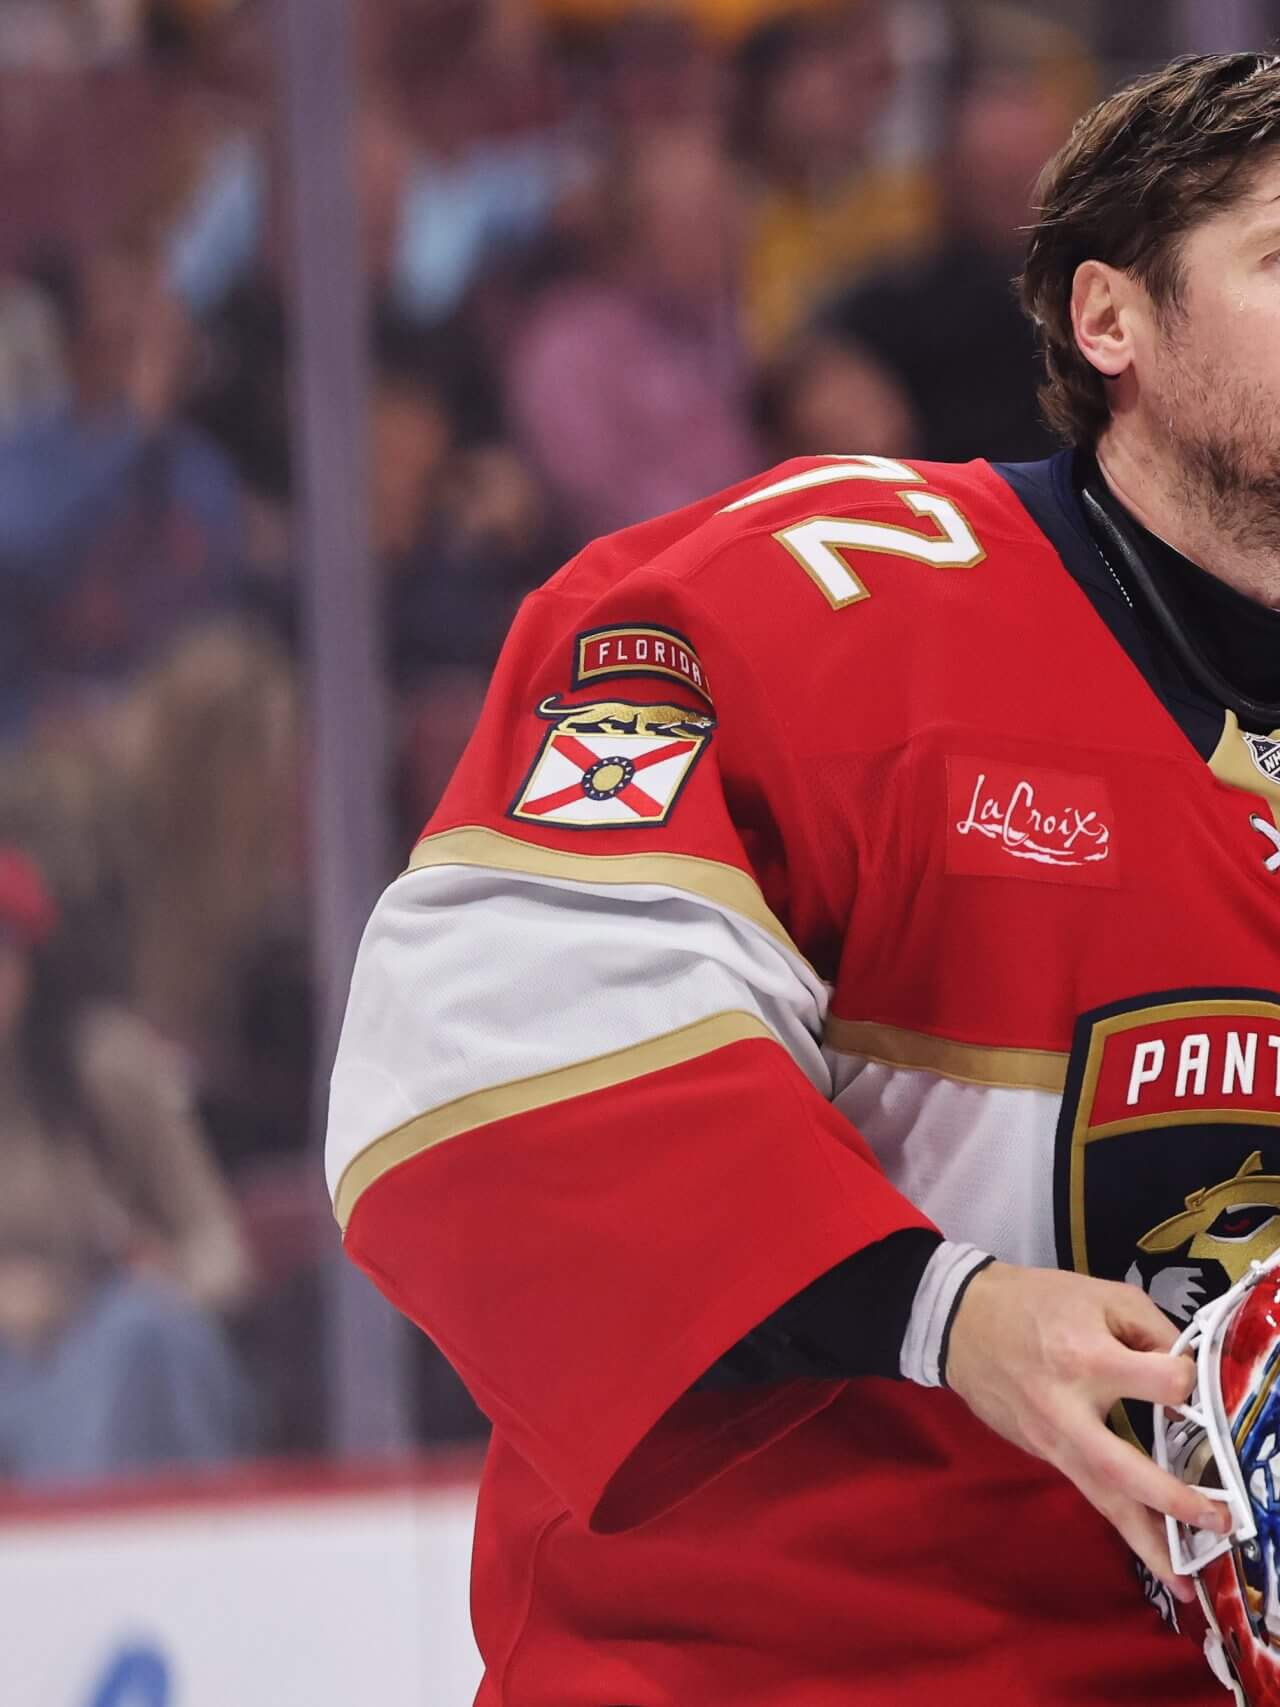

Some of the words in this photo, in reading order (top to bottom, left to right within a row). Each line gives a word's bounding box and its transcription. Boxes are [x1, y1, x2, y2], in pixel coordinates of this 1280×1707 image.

[714, 455, 988, 611] 72
[598, 638, 703, 687] FLORIDA
[956, 773, 1109, 849] LaCroix
